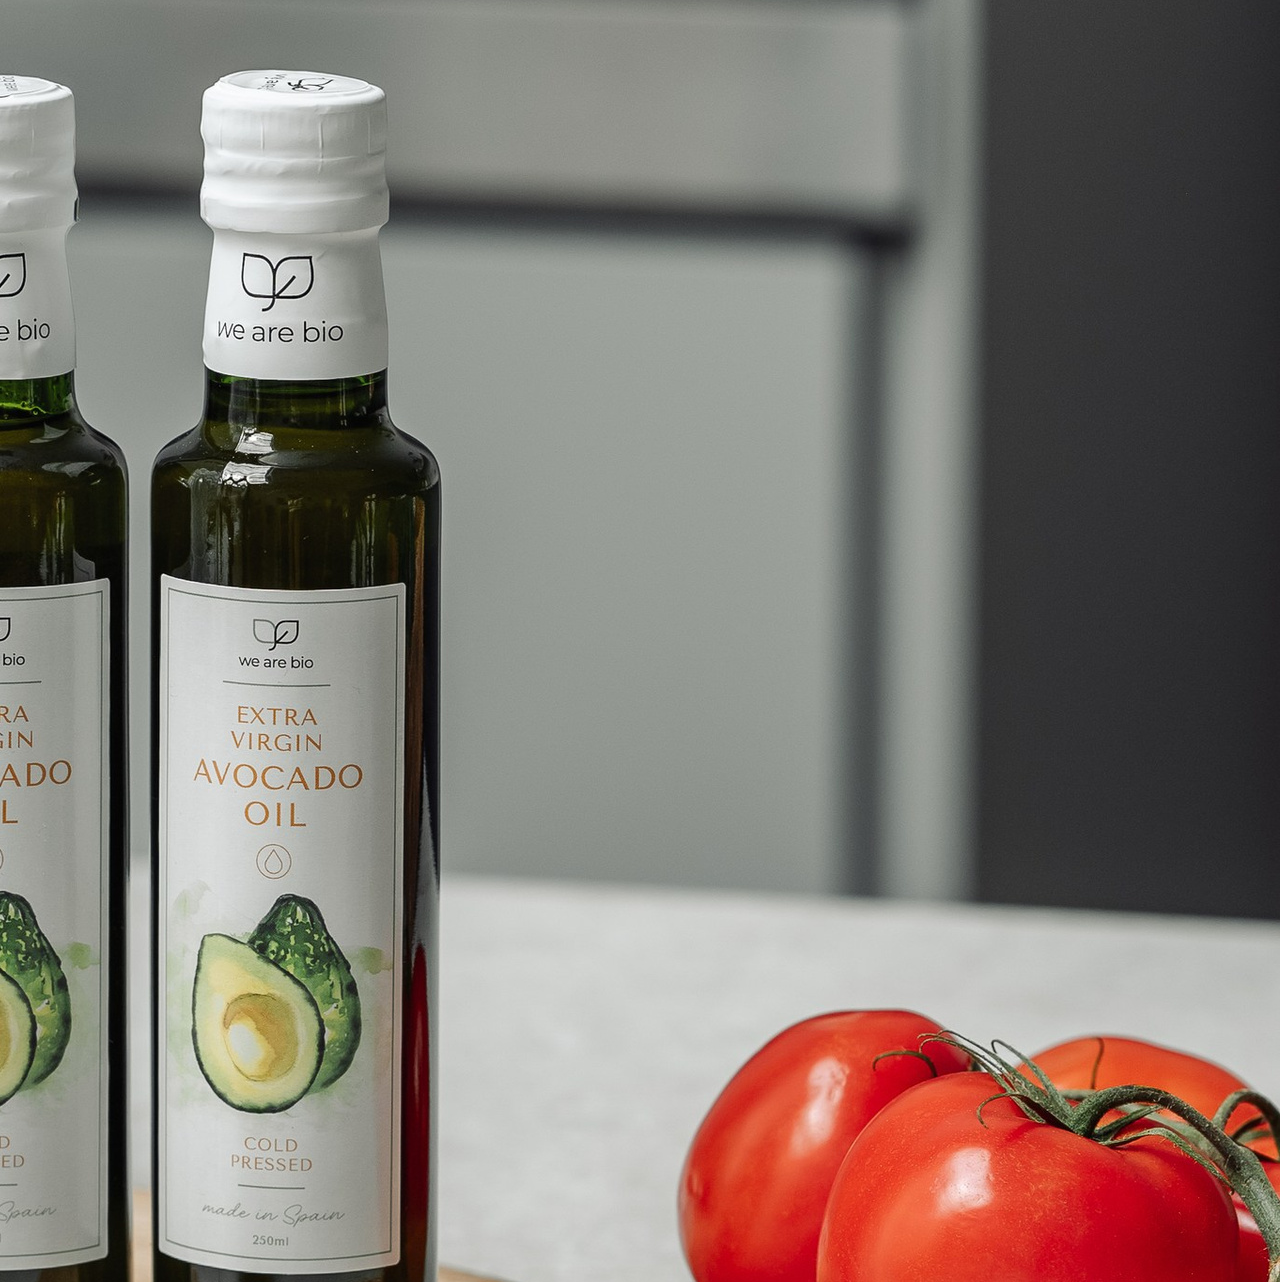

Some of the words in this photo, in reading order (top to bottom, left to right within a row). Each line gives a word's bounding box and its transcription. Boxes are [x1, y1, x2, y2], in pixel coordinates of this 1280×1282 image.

[17, 318, 51, 340] bio
[217, 320, 245, 341] we
[251, 325, 295, 343] are
[302, 320, 344, 343] bio
[2, 653, 26, 666] bio
[238, 656, 260, 667] we
[263, 658, 287, 668] are
[290, 656, 314, 668] bio
[237, 705, 318, 726] EXTRA
[231, 731, 323, 751] VIRGIN
[193, 759, 364, 790] AVOCADO
[244, 801, 307, 827] OIL
[244, 1136, 298, 1152] COLD
[231, 1154, 313, 1172] PRESSED
[202, 1202, 251, 1218] made
[255, 1208, 278, 1221] in
[282, 1204, 345, 1227] Spain
[252, 1234, 289, 1247] 250ml
